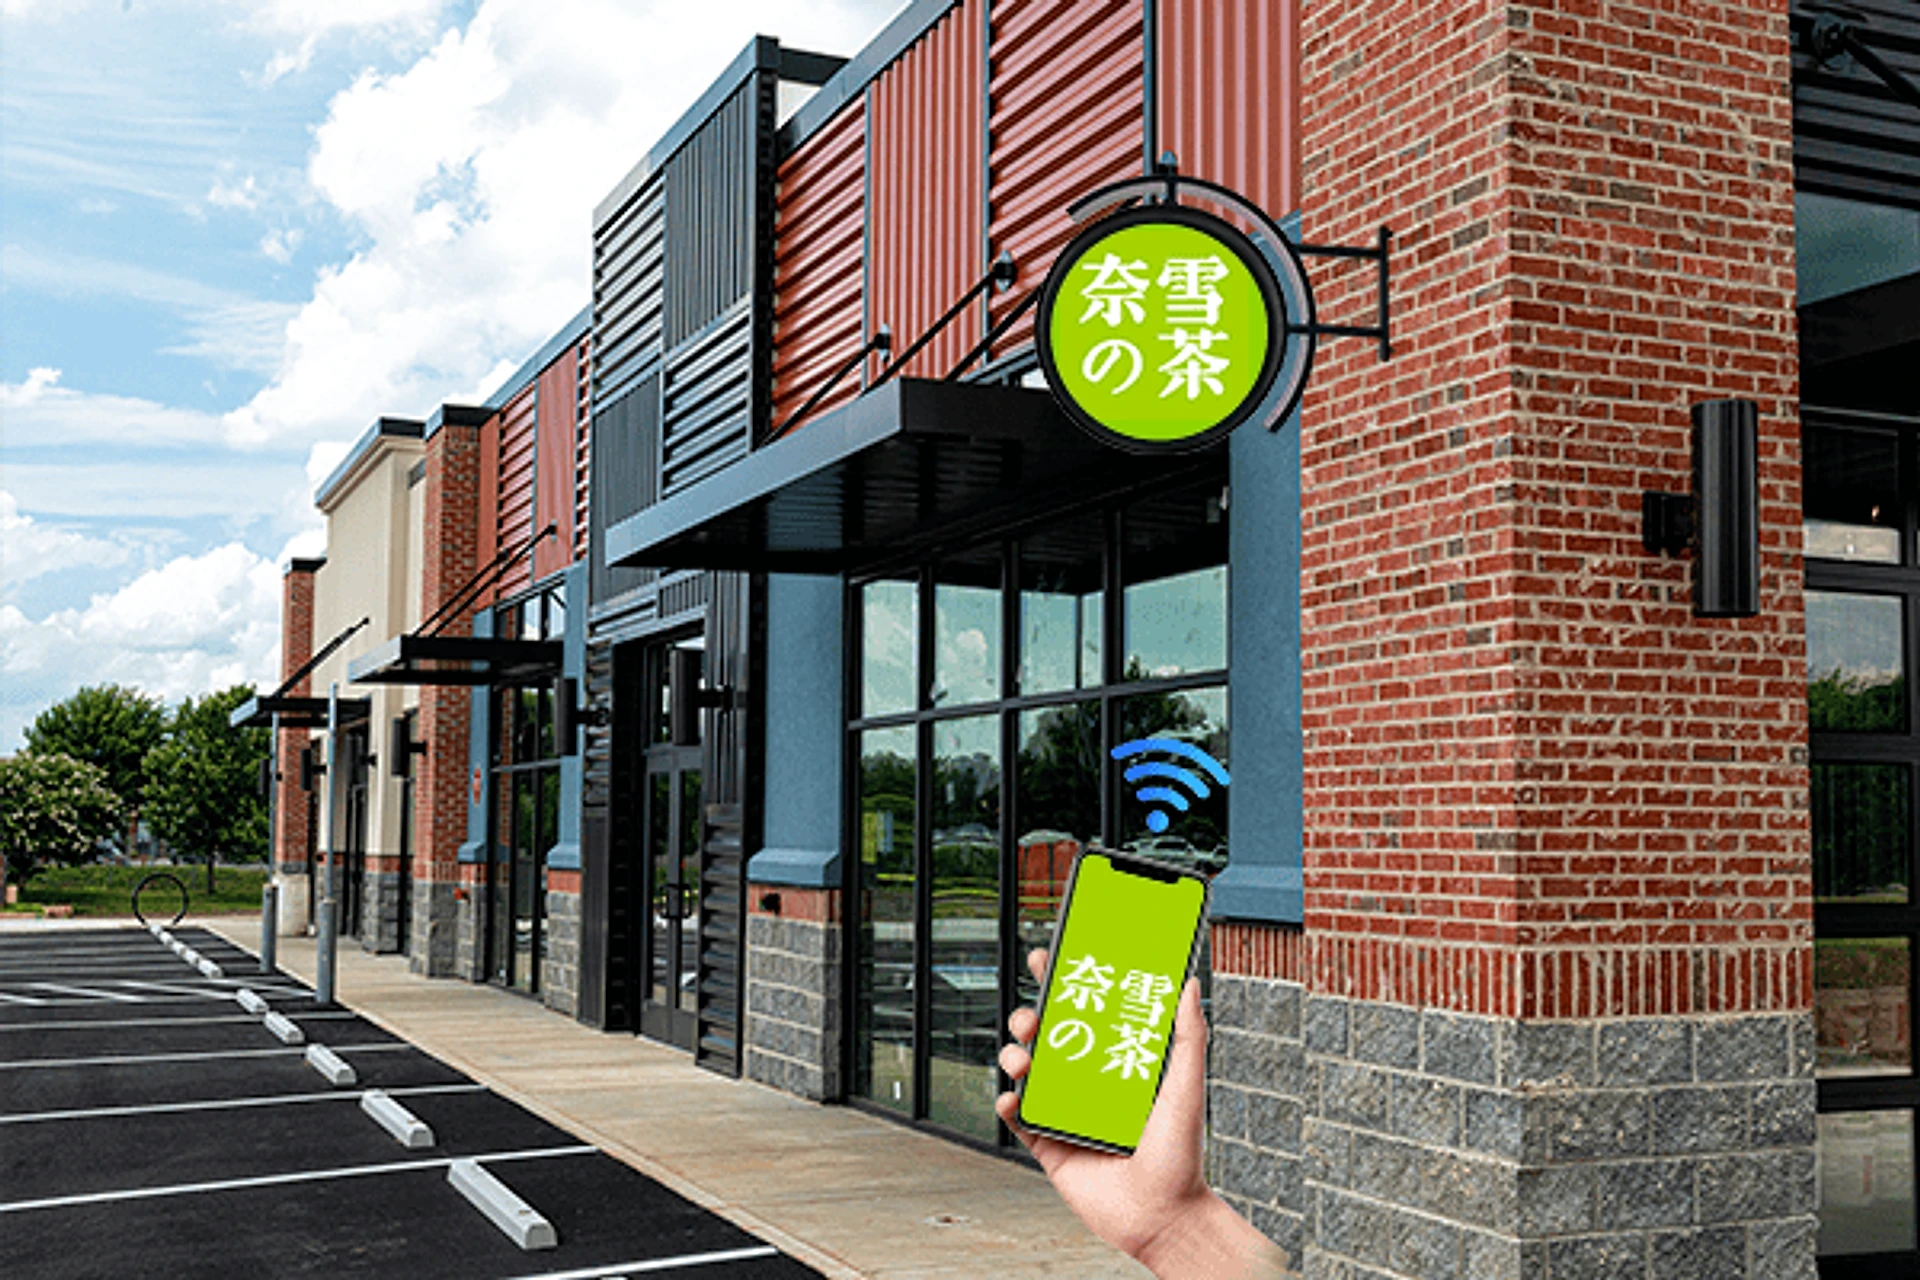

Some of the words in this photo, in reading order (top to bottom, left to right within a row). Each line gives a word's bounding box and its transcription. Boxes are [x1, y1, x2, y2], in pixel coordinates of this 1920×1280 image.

[1079, 253, 1230, 327] 奈雪
[1081, 328, 1230, 400] の茶
[1055, 954, 1175, 1028] 奈雪
[1048, 1019, 1162, 1081] の茶
